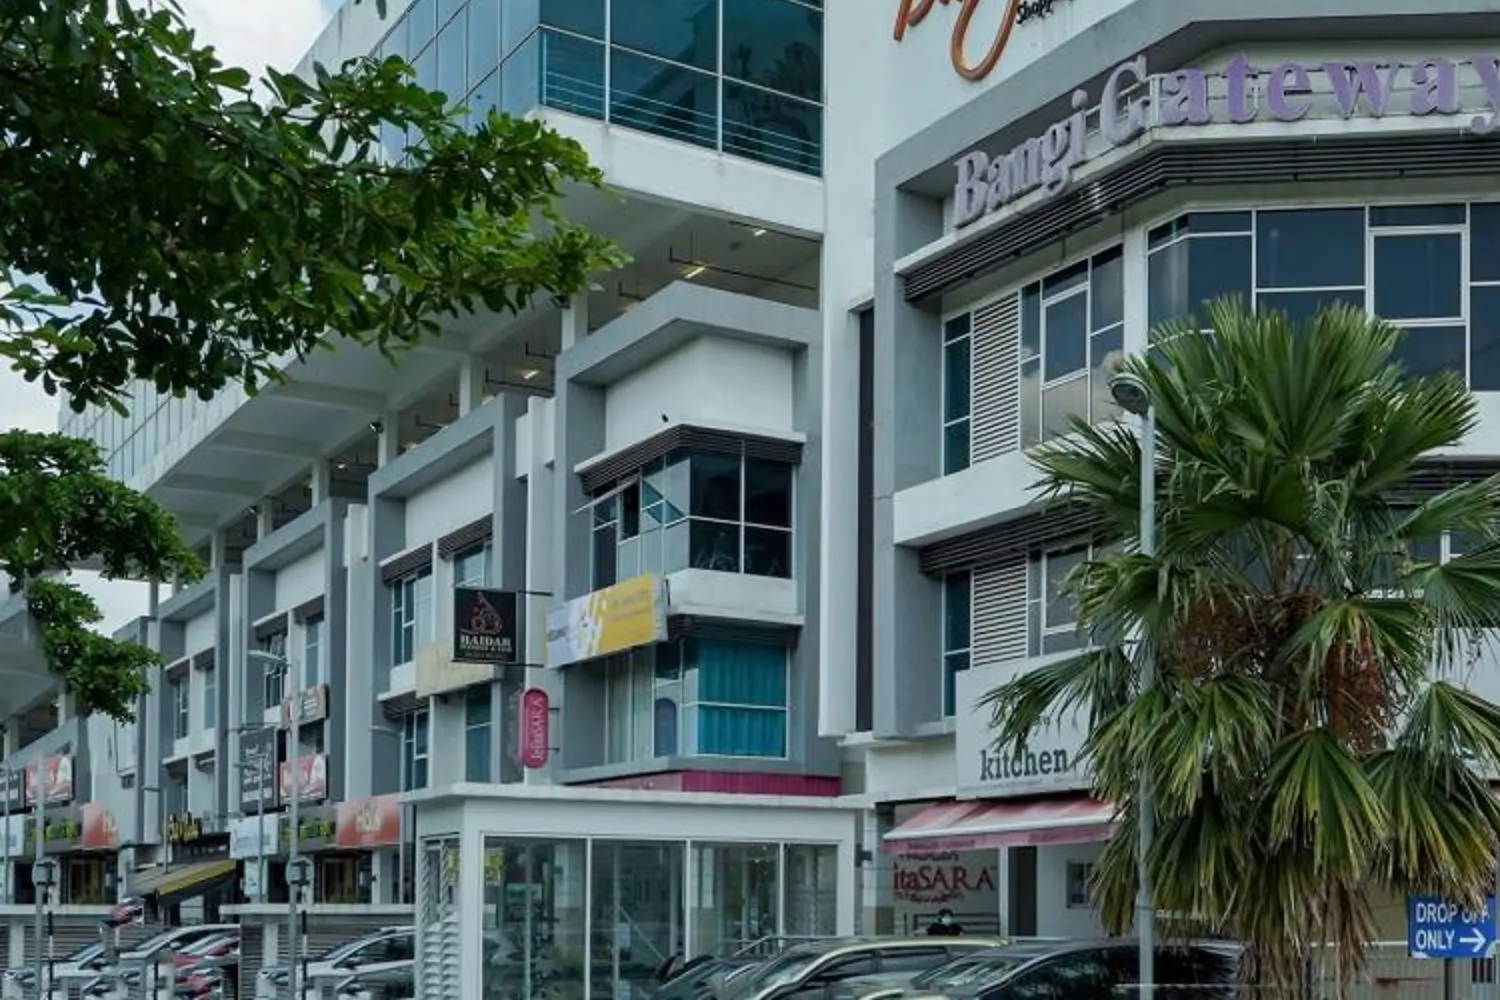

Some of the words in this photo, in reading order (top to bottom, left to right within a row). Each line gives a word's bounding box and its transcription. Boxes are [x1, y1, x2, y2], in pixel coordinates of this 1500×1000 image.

[955, 89, 1088, 229] Bangi
[980, 740, 1069, 781] kitchen
[1416, 903, 1458, 924] DROP
[1416, 929, 1455, 950] ONLY
